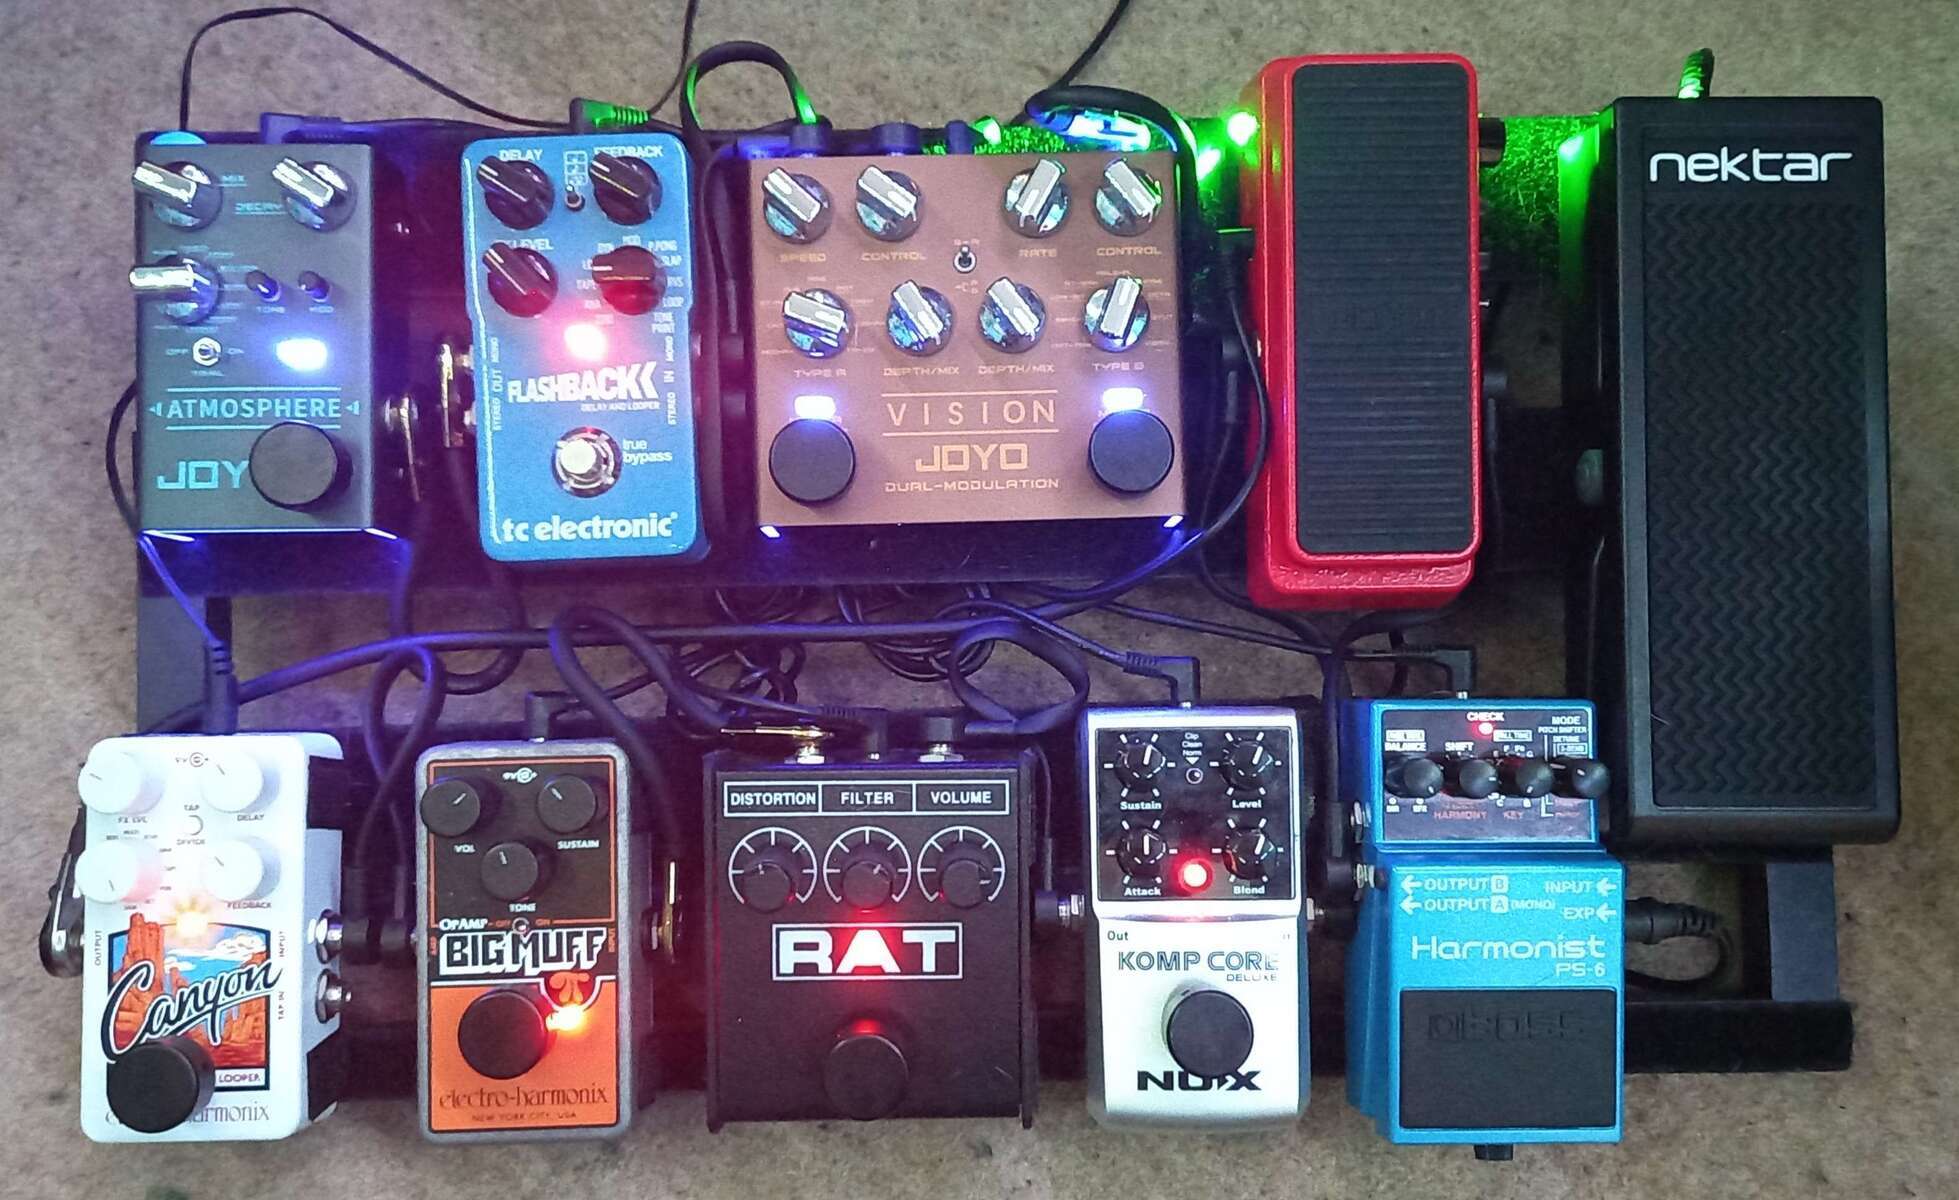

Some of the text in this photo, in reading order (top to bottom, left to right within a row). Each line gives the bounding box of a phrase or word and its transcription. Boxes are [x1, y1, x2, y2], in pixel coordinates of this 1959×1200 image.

[499, 148, 544, 161] DELAY
[593, 145, 663, 158] FEEDBACK
[1649, 146, 1853, 183] nektar
[861, 252, 927, 262] CONTROL
[1018, 248, 1058, 258] RATE
[1096, 246, 1163, 256] CONTROL
[779, 253, 827, 263] SPEED
[793, 368, 835, 378] TYPE
[882, 366, 960, 377] DEPTH/MIX
[978, 364, 1056, 375] DEPTH/MIX
[1092, 362, 1130, 372] TYPE
[507, 361, 659, 404] FLASHBACK
[166, 397, 342, 419] ATMOSPHERE
[886, 399, 1056, 427] VISION
[622, 438, 648, 450] true
[622, 450, 673, 466] bypass
[914, 442, 1029, 473] JOYO
[156, 459, 250, 490] JOY
[884, 477, 1060, 494] DUAL-MODULATION
[502, 512, 674, 543] tc electronic
[1466, 711, 1505, 722] CHECK
[1551, 715, 1582, 726] MODE
[1385, 741, 1427, 752] BALANCE
[1445, 741, 1475, 752] SHIFT
[730, 791, 817, 807] DISTORTION
[840, 790, 895, 806] FILTER
[930, 790, 993, 805] VOLUME
[1119, 801, 1162, 811] Sustain
[1231, 799, 1263, 809] Level
[236, 813, 265, 822] DELAY
[1433, 810, 1488, 820] HARMONY
[1503, 810, 1524, 820] KEY
[453, 844, 476, 854] VOL
[557, 839, 600, 850] SUSTAIN
[1232, 885, 1266, 896] Blend
[1423, 877, 1490, 892] OUTPUT
[1545, 880, 1594, 894] INPUT
[1123, 886, 1162, 897] Attack
[226, 901, 273, 910] FEEDBACK
[509, 903, 537, 913] TONE
[1423, 898, 1490, 912] OUTPUT
[1491, 895, 1509, 914] A
[1562, 907, 1596, 920] EXP
[1106, 930, 1130, 942] Out
[94, 929, 103, 967] OUTPUT
[441, 928, 606, 974] BIG MUFF
[777, 928, 957, 975] RAT
[1411, 933, 1607, 960] Harmonist
[1117, 950, 1280, 972] KOMP CORE
[1555, 962, 1607, 978] PS-6
[100, 960, 283, 1064] Canyon
[218, 1072, 261, 1083] LOOPER
[438, 1081, 609, 1109] electro-harmonix
